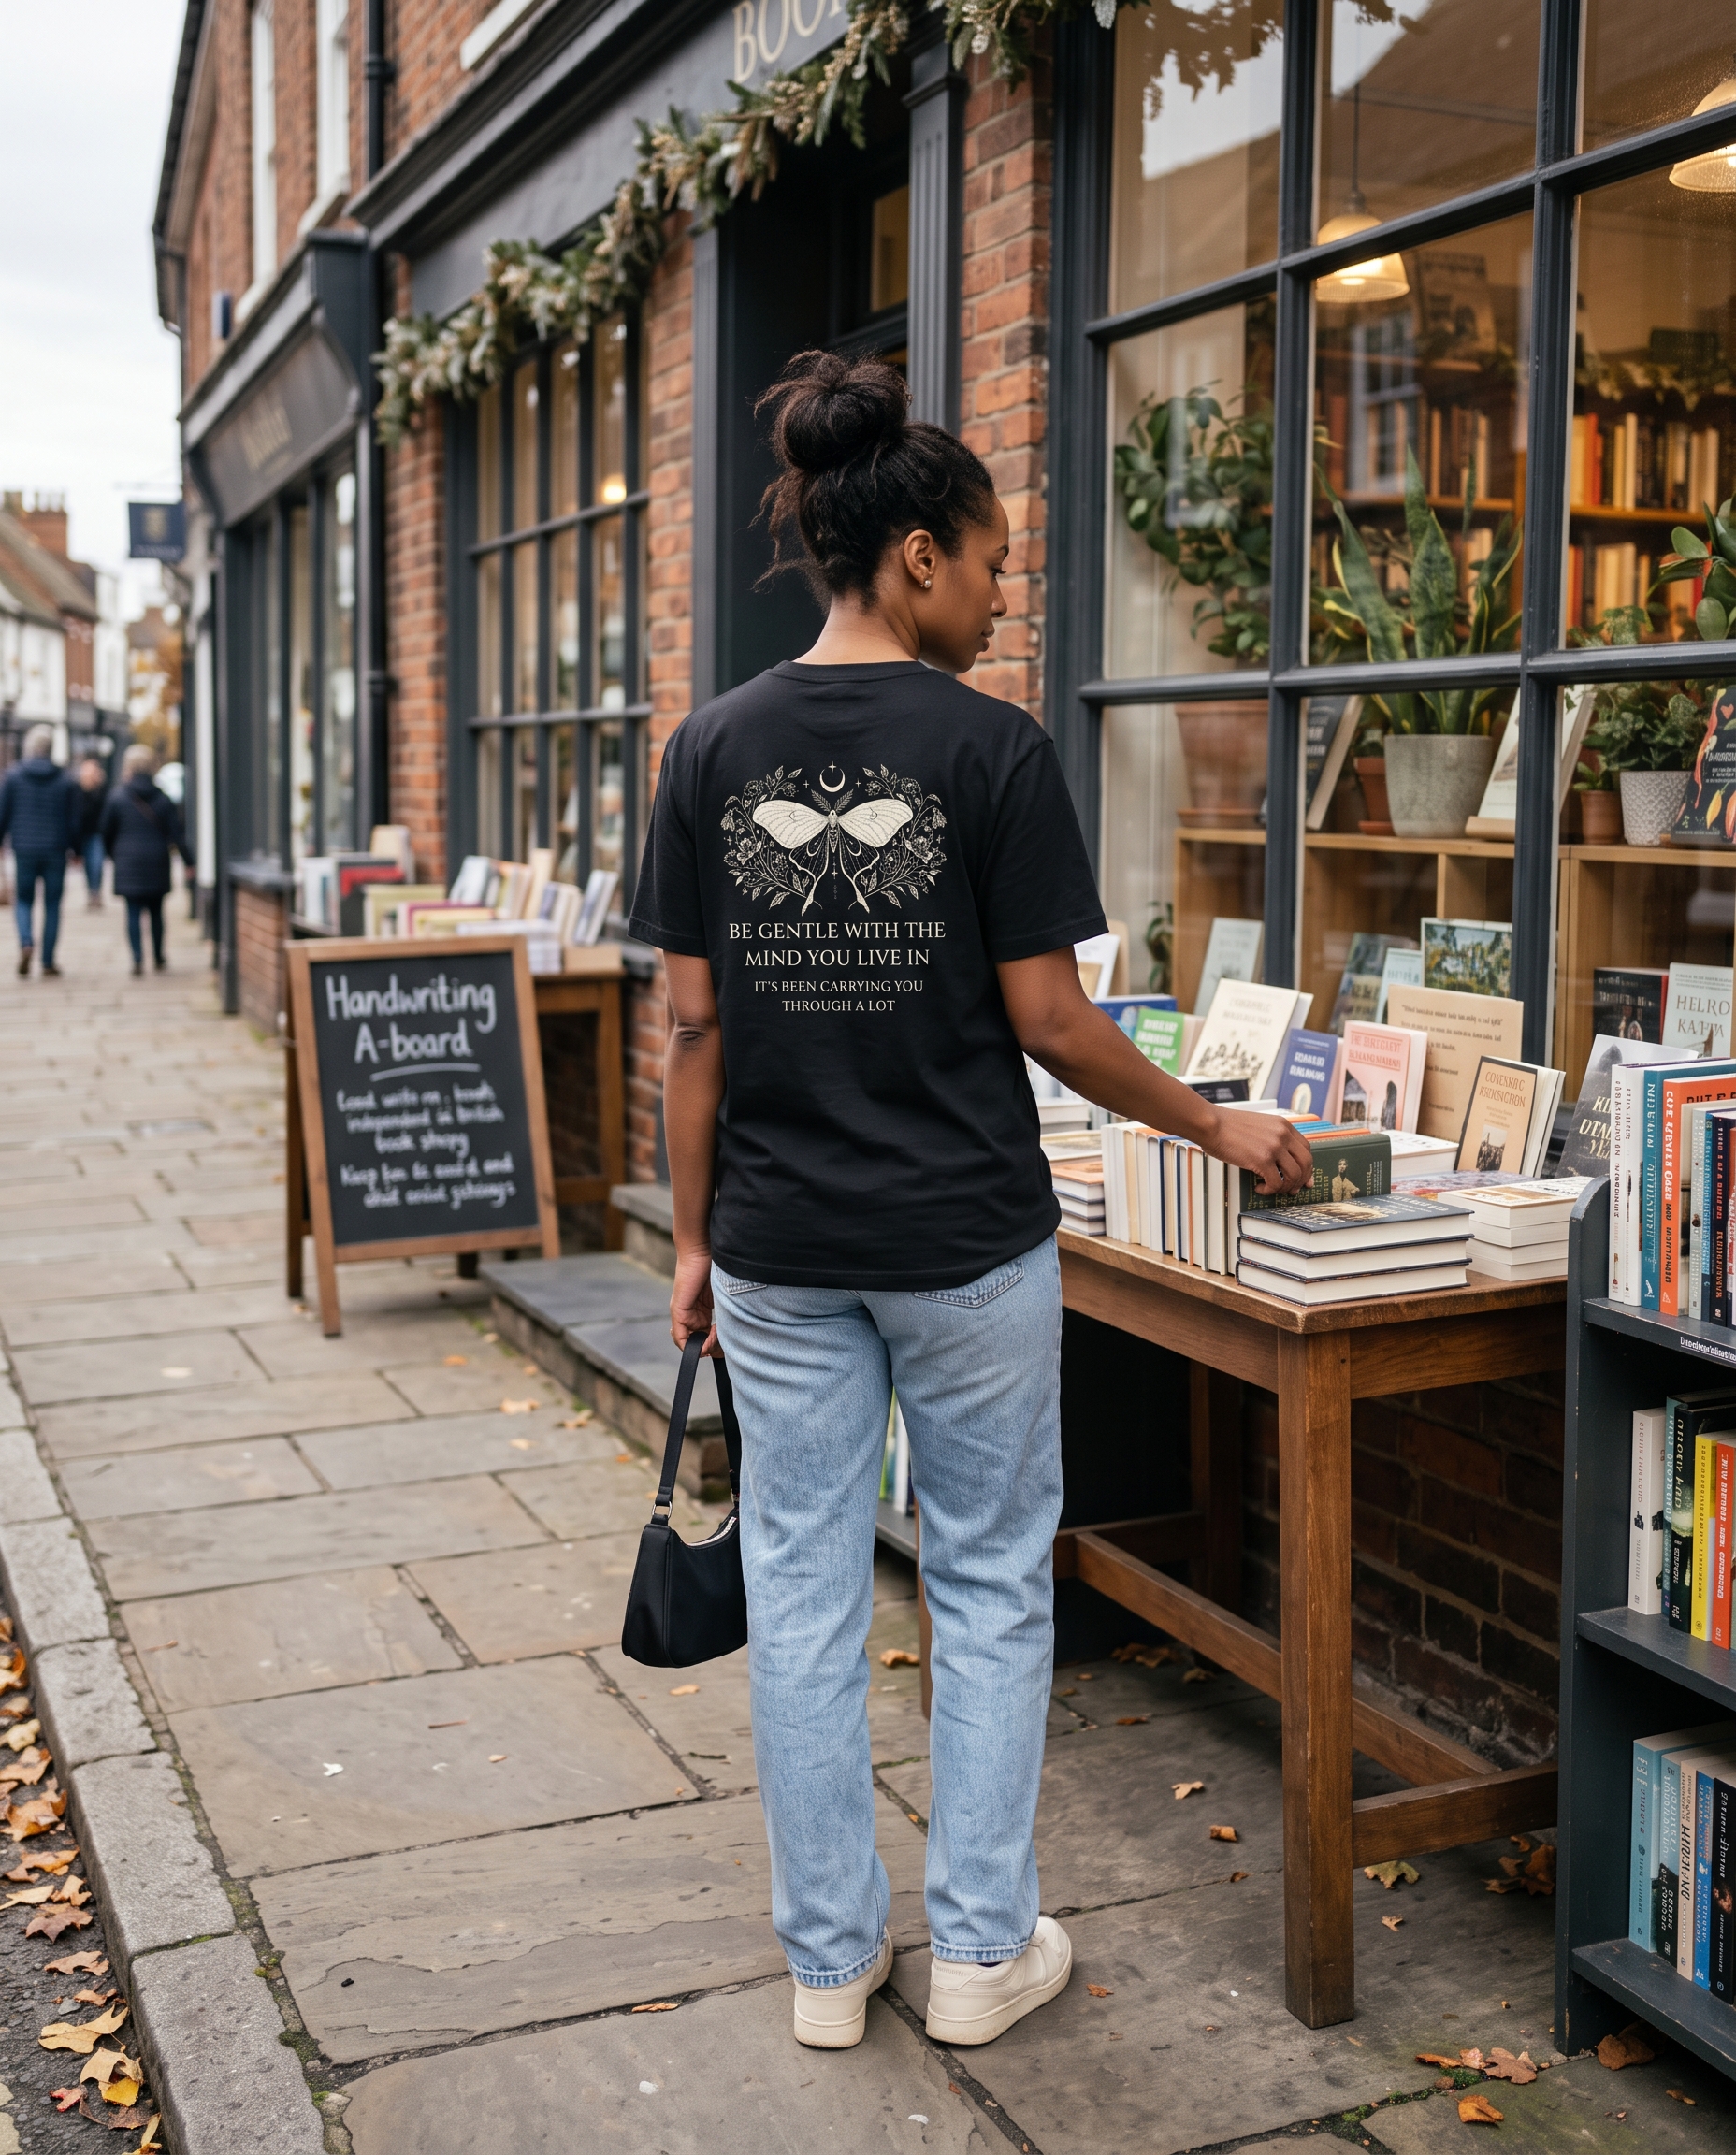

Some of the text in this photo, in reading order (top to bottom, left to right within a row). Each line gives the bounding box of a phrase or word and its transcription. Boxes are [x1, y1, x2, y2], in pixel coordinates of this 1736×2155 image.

[732, 0, 841, 83] BOO
[729, 921, 946, 939] BE GENTLE WITH THE
[745, 948, 930, 966] MIND YOU LIVE IN
[755, 980, 923, 992] IT'S BEEN CARRYING YOU
[326, 973, 497, 1034] Handwriting
[781, 1000, 896, 1012] THROUGH A LOT
[354, 1017, 473, 1064] A-board
